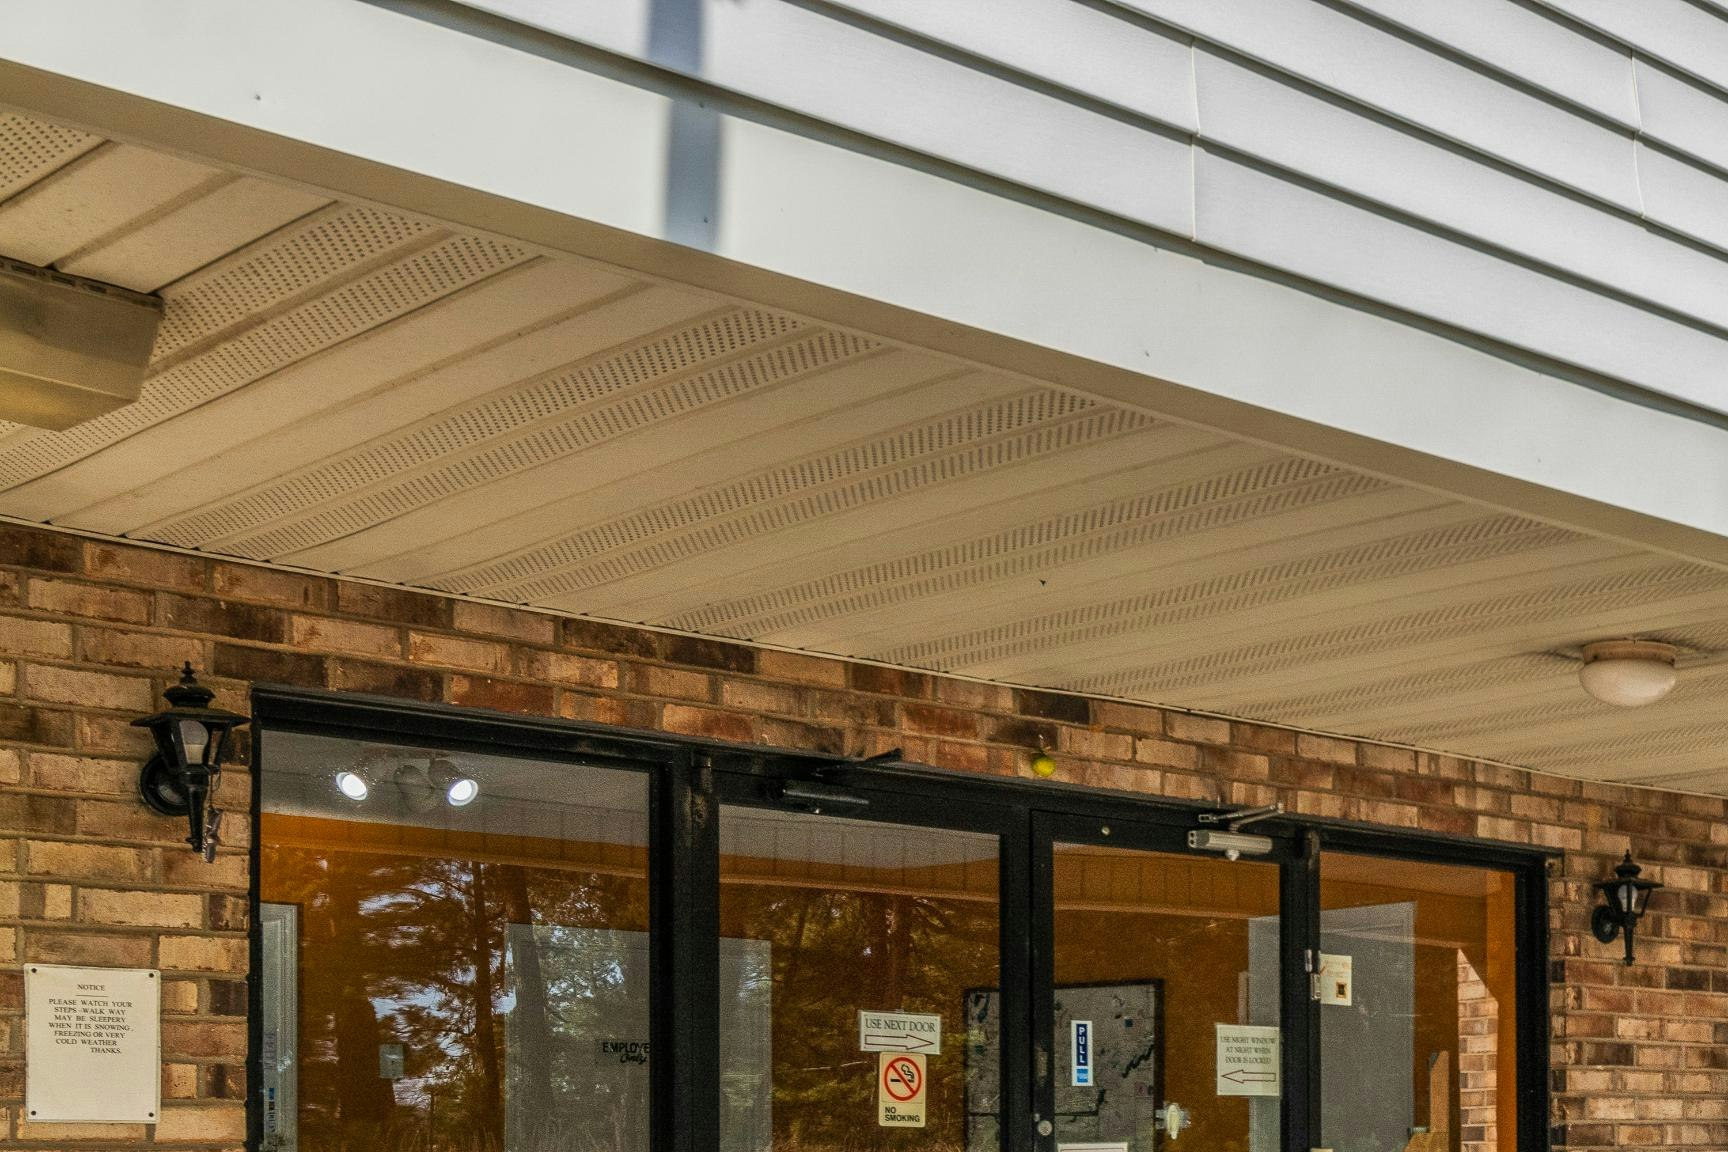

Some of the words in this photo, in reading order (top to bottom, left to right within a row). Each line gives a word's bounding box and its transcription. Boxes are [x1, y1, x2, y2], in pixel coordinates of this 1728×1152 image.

[49, 998, 77, 1006] PLEASE
[112, 1000, 133, 1008] YOUR
[83, 1007, 105, 1015] WALK
[108, 1008, 126, 1016] WAY
[865, 1018, 882, 1030] USE
[883, 1019, 907, 1031] NEXT
[909, 1021, 936, 1033] DOOR
[1078, 1027, 1086, 1064] PULL
[884, 1106, 897, 1114] NO
[884, 1114, 921, 1123] SMOKING
